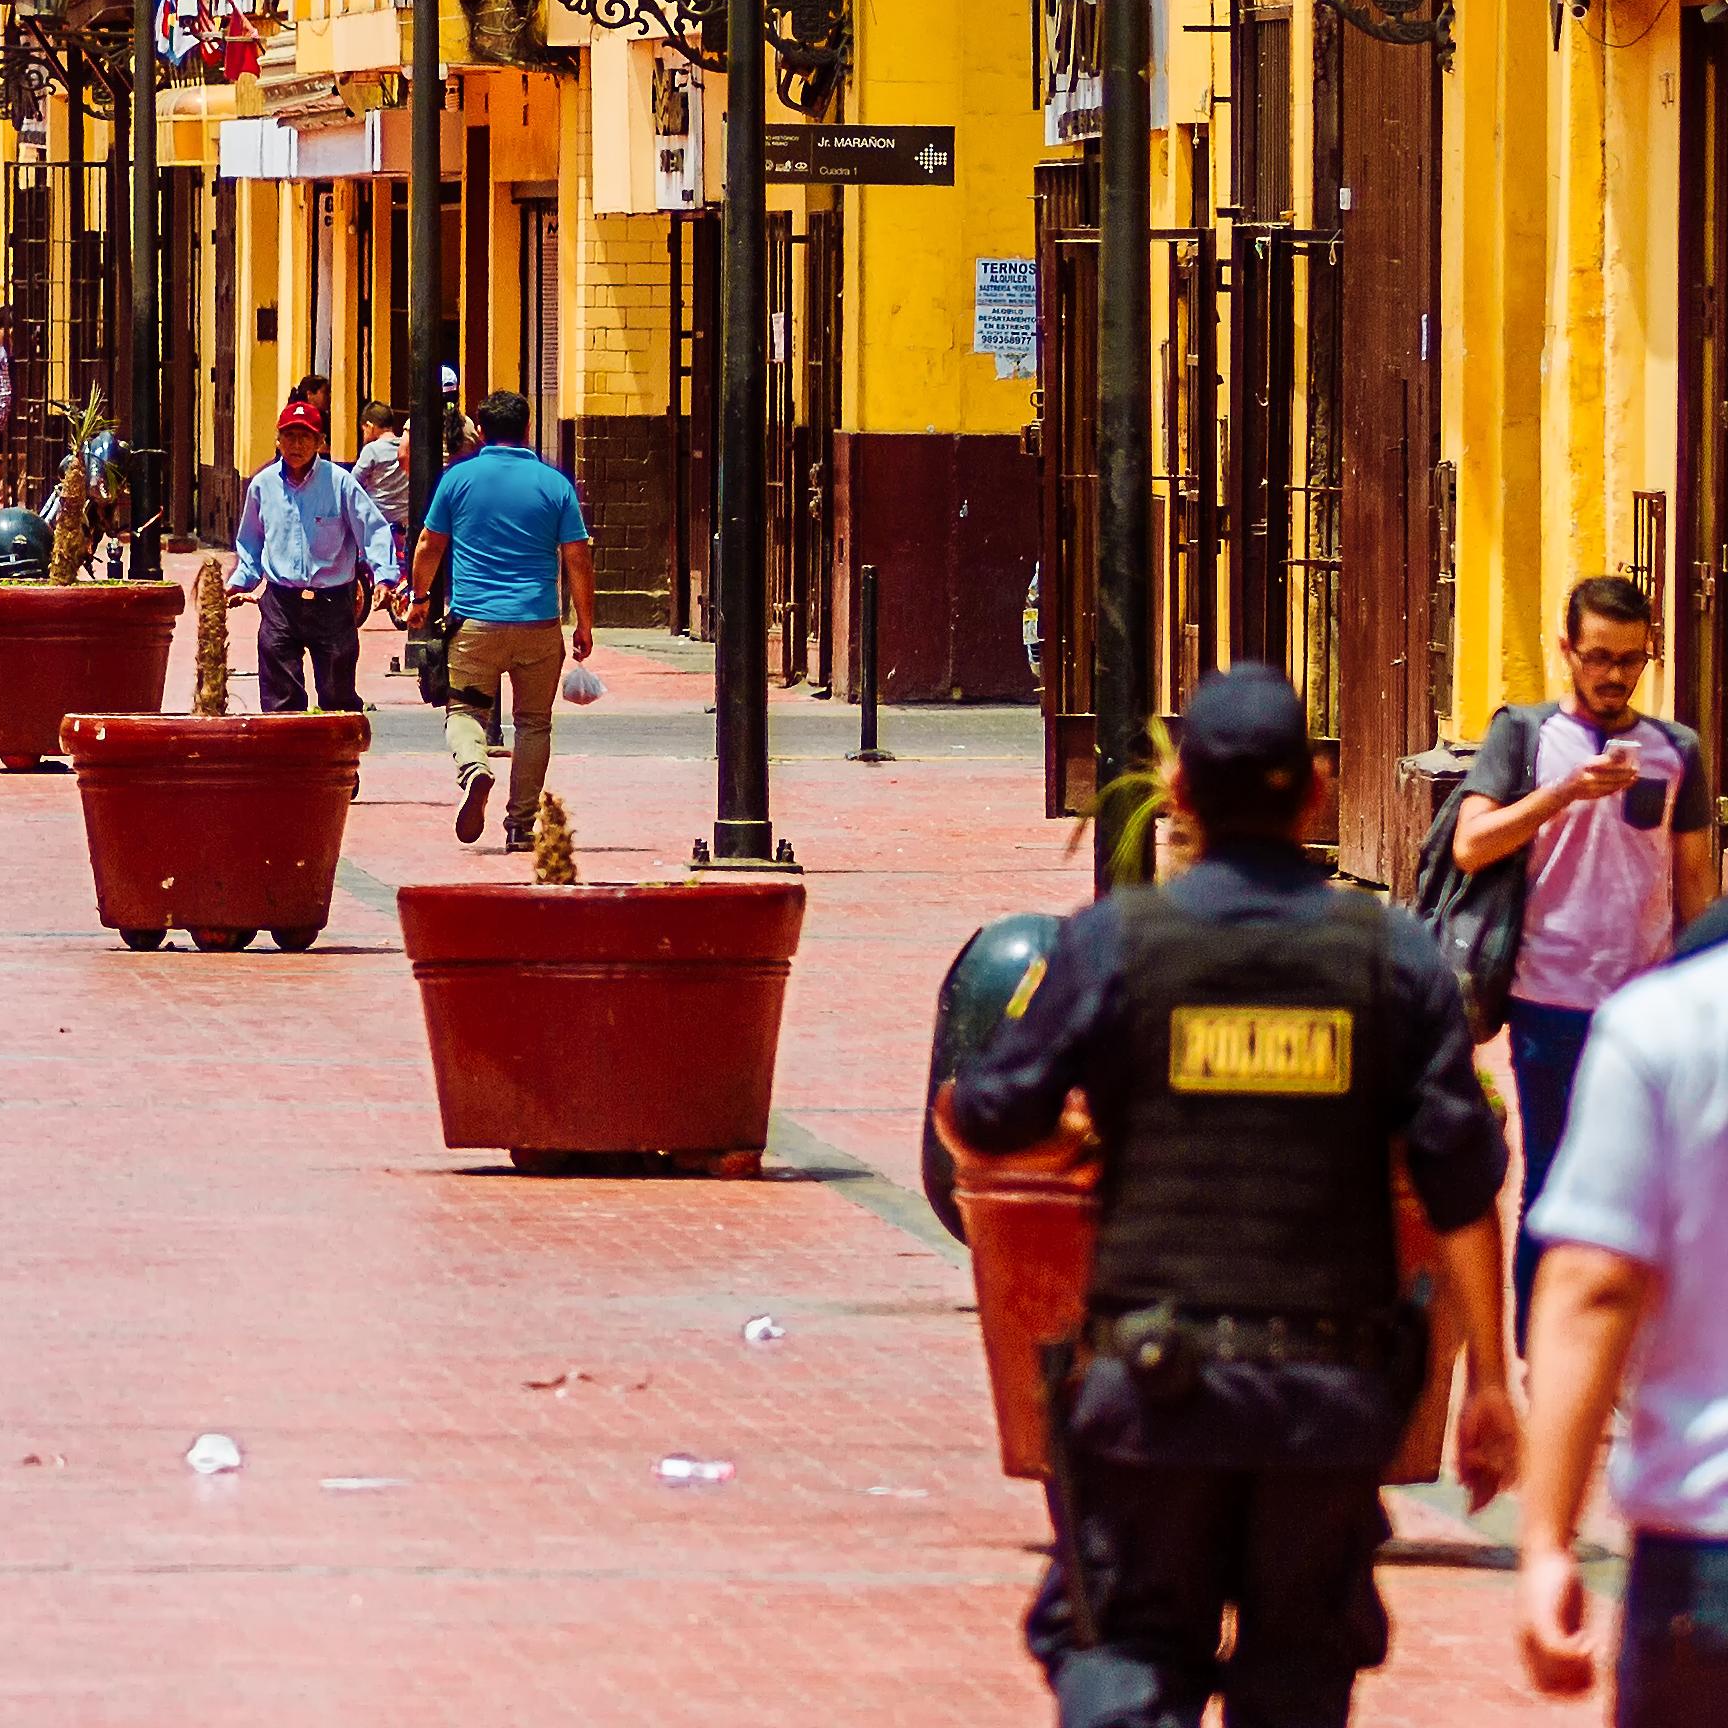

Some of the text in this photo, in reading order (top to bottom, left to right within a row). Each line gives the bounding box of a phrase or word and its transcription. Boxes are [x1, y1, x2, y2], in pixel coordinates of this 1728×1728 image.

[817, 136, 896, 149] Jr. MARAÑON
[819, 166, 858, 176] Cuadra 1
[981, 262, 1036, 275] TERNOS
[989, 274, 1028, 283] ALQUILER
